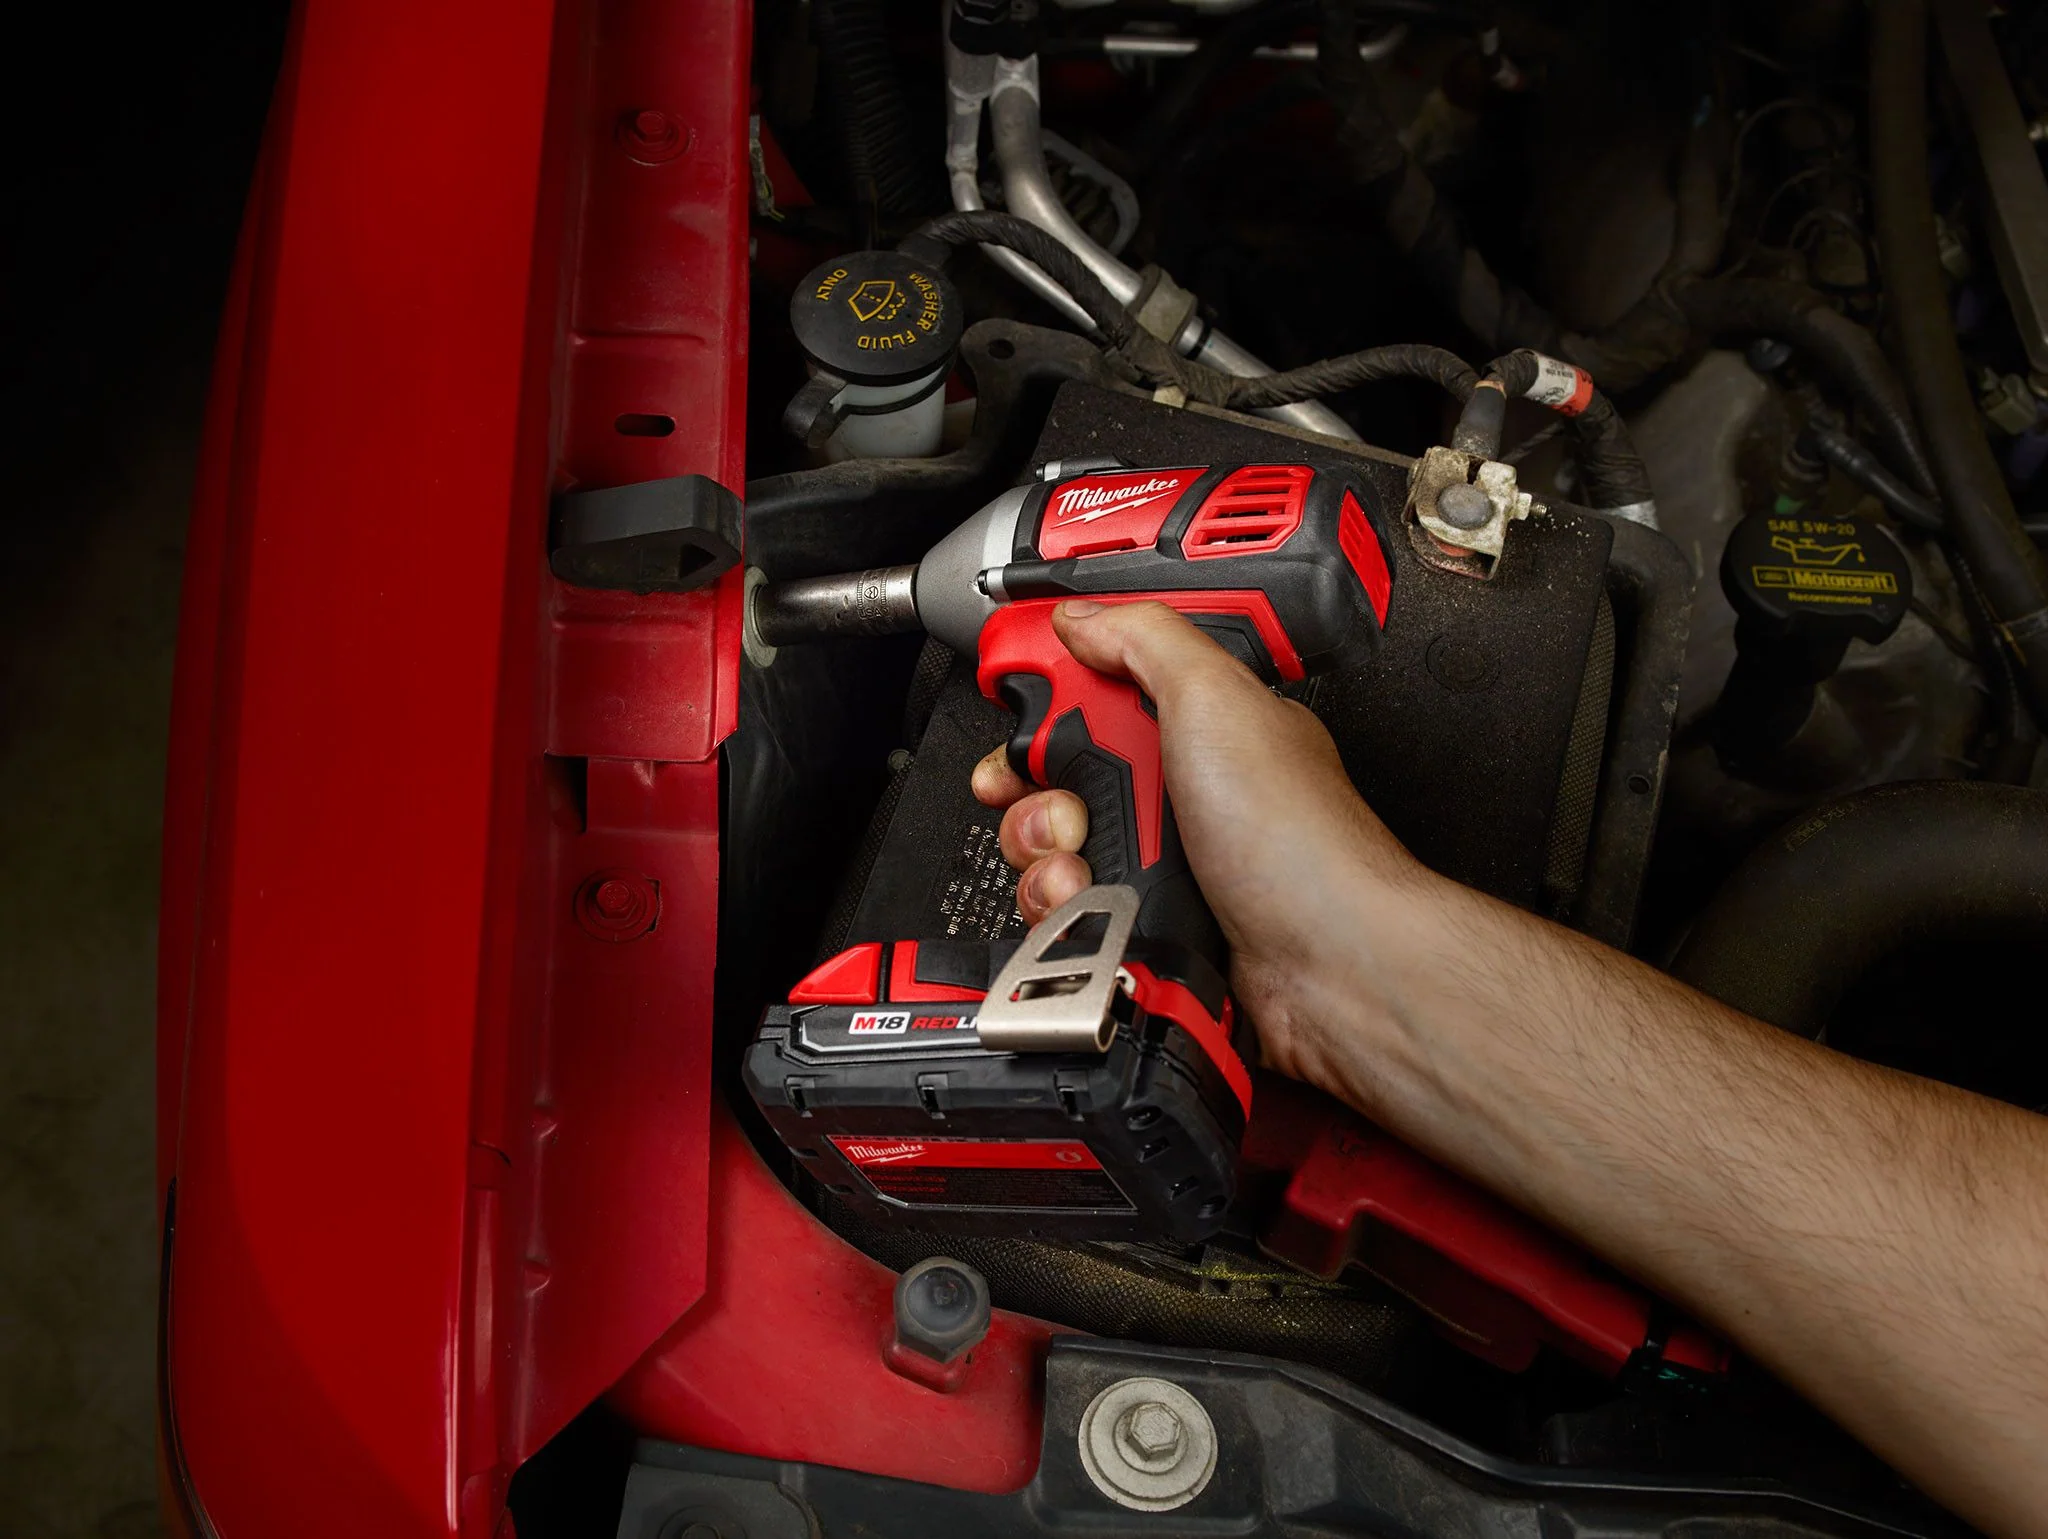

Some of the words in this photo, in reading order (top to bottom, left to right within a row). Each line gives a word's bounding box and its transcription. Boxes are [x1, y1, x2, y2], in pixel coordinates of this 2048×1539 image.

[816, 268, 848, 301] ONLY
[908, 273, 939, 331] WASHER
[857, 330, 917, 350] FLUID
[1057, 478, 1179, 517] Milwaukee
[1767, 518, 1799, 533] SAE
[1802, 520, 1856, 537] 5W-20
[1794, 570, 1889, 592] Motorcraft
[1787, 591, 1873, 606] Recommended
[854, 1016, 906, 1030] M18
[911, 1016, 979, 1030] REDLI
[846, 1143, 926, 1160] Milwaukee
